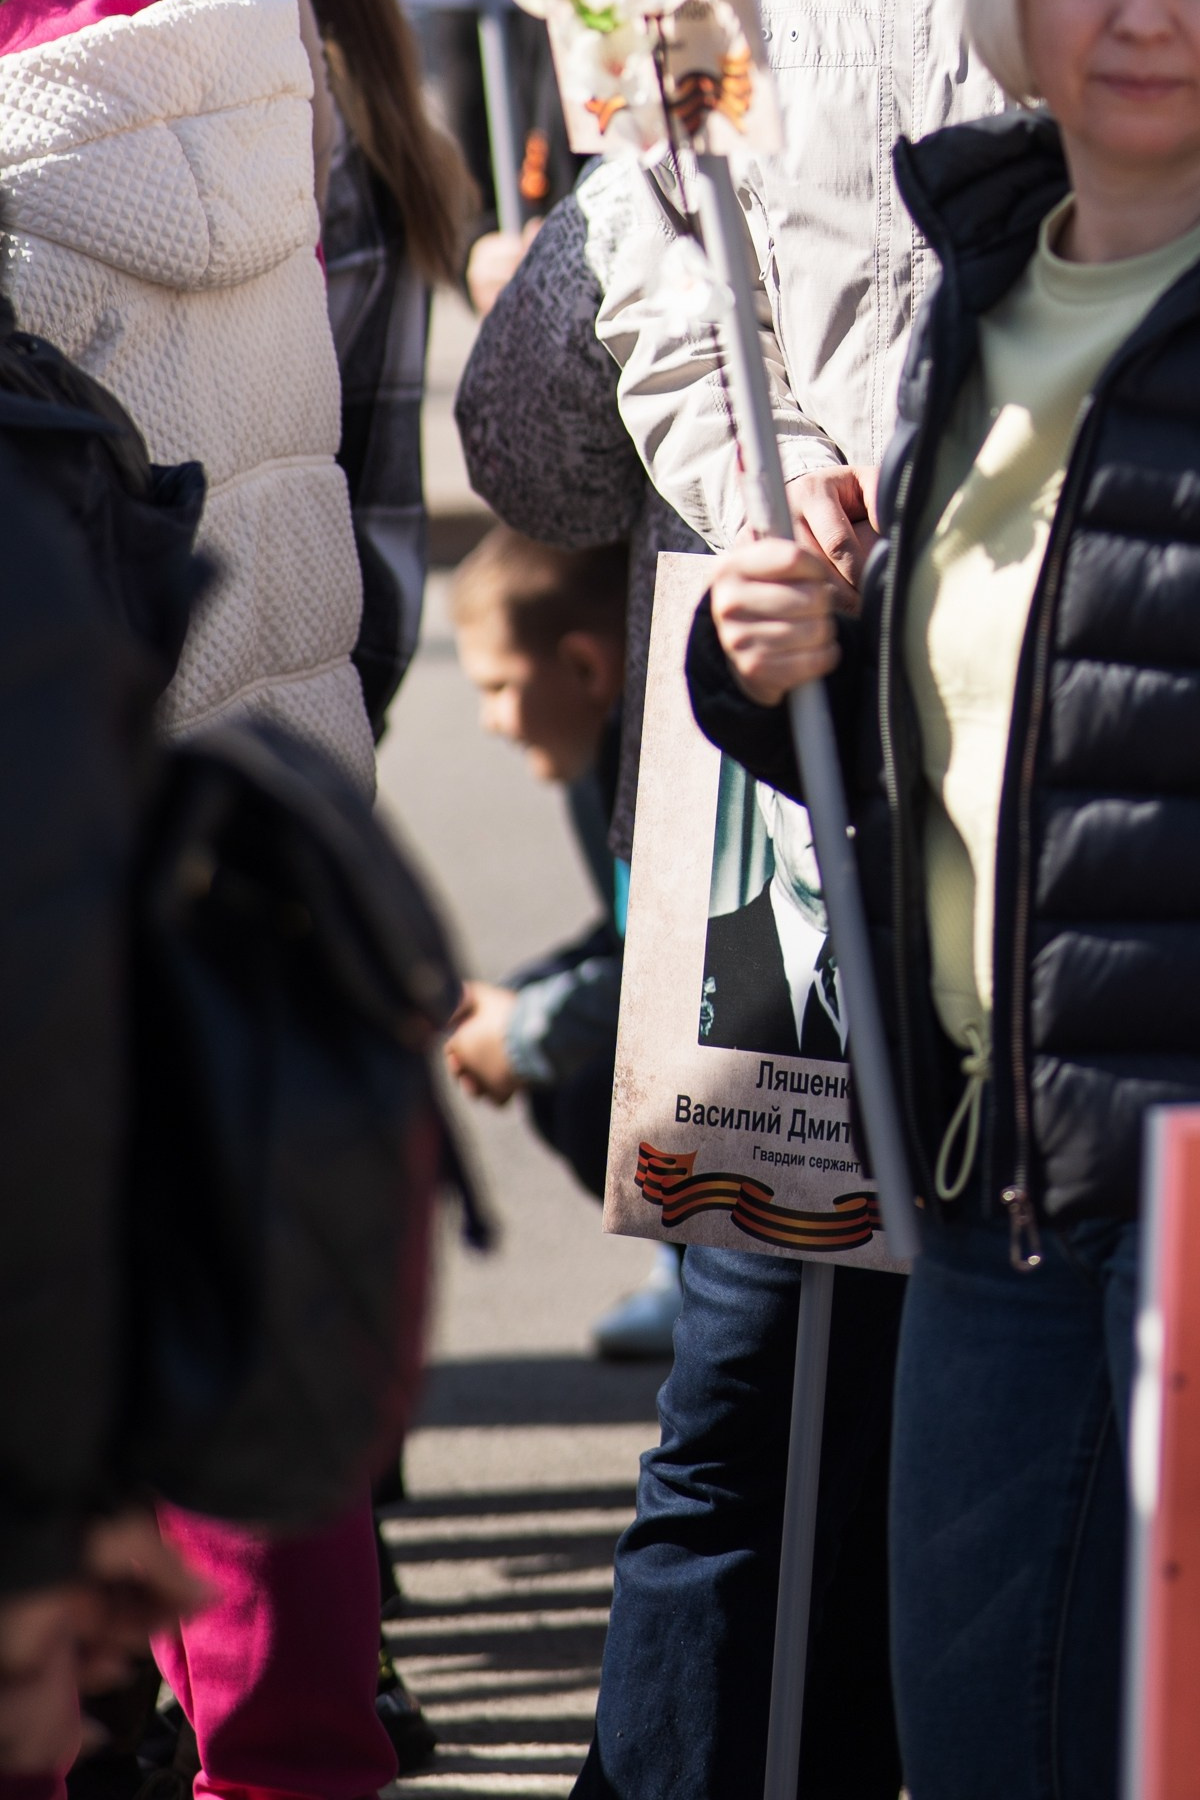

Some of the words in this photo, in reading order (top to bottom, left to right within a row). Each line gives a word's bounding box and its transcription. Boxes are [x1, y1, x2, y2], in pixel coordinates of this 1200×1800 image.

[756, 1060, 850, 1099] Ляшенк
[675, 1094, 781, 1135] Василий
[787, 1108, 851, 1144] Дмит
[753, 1146, 805, 1167] Гвардии
[809, 1156, 861, 1173] сержант
